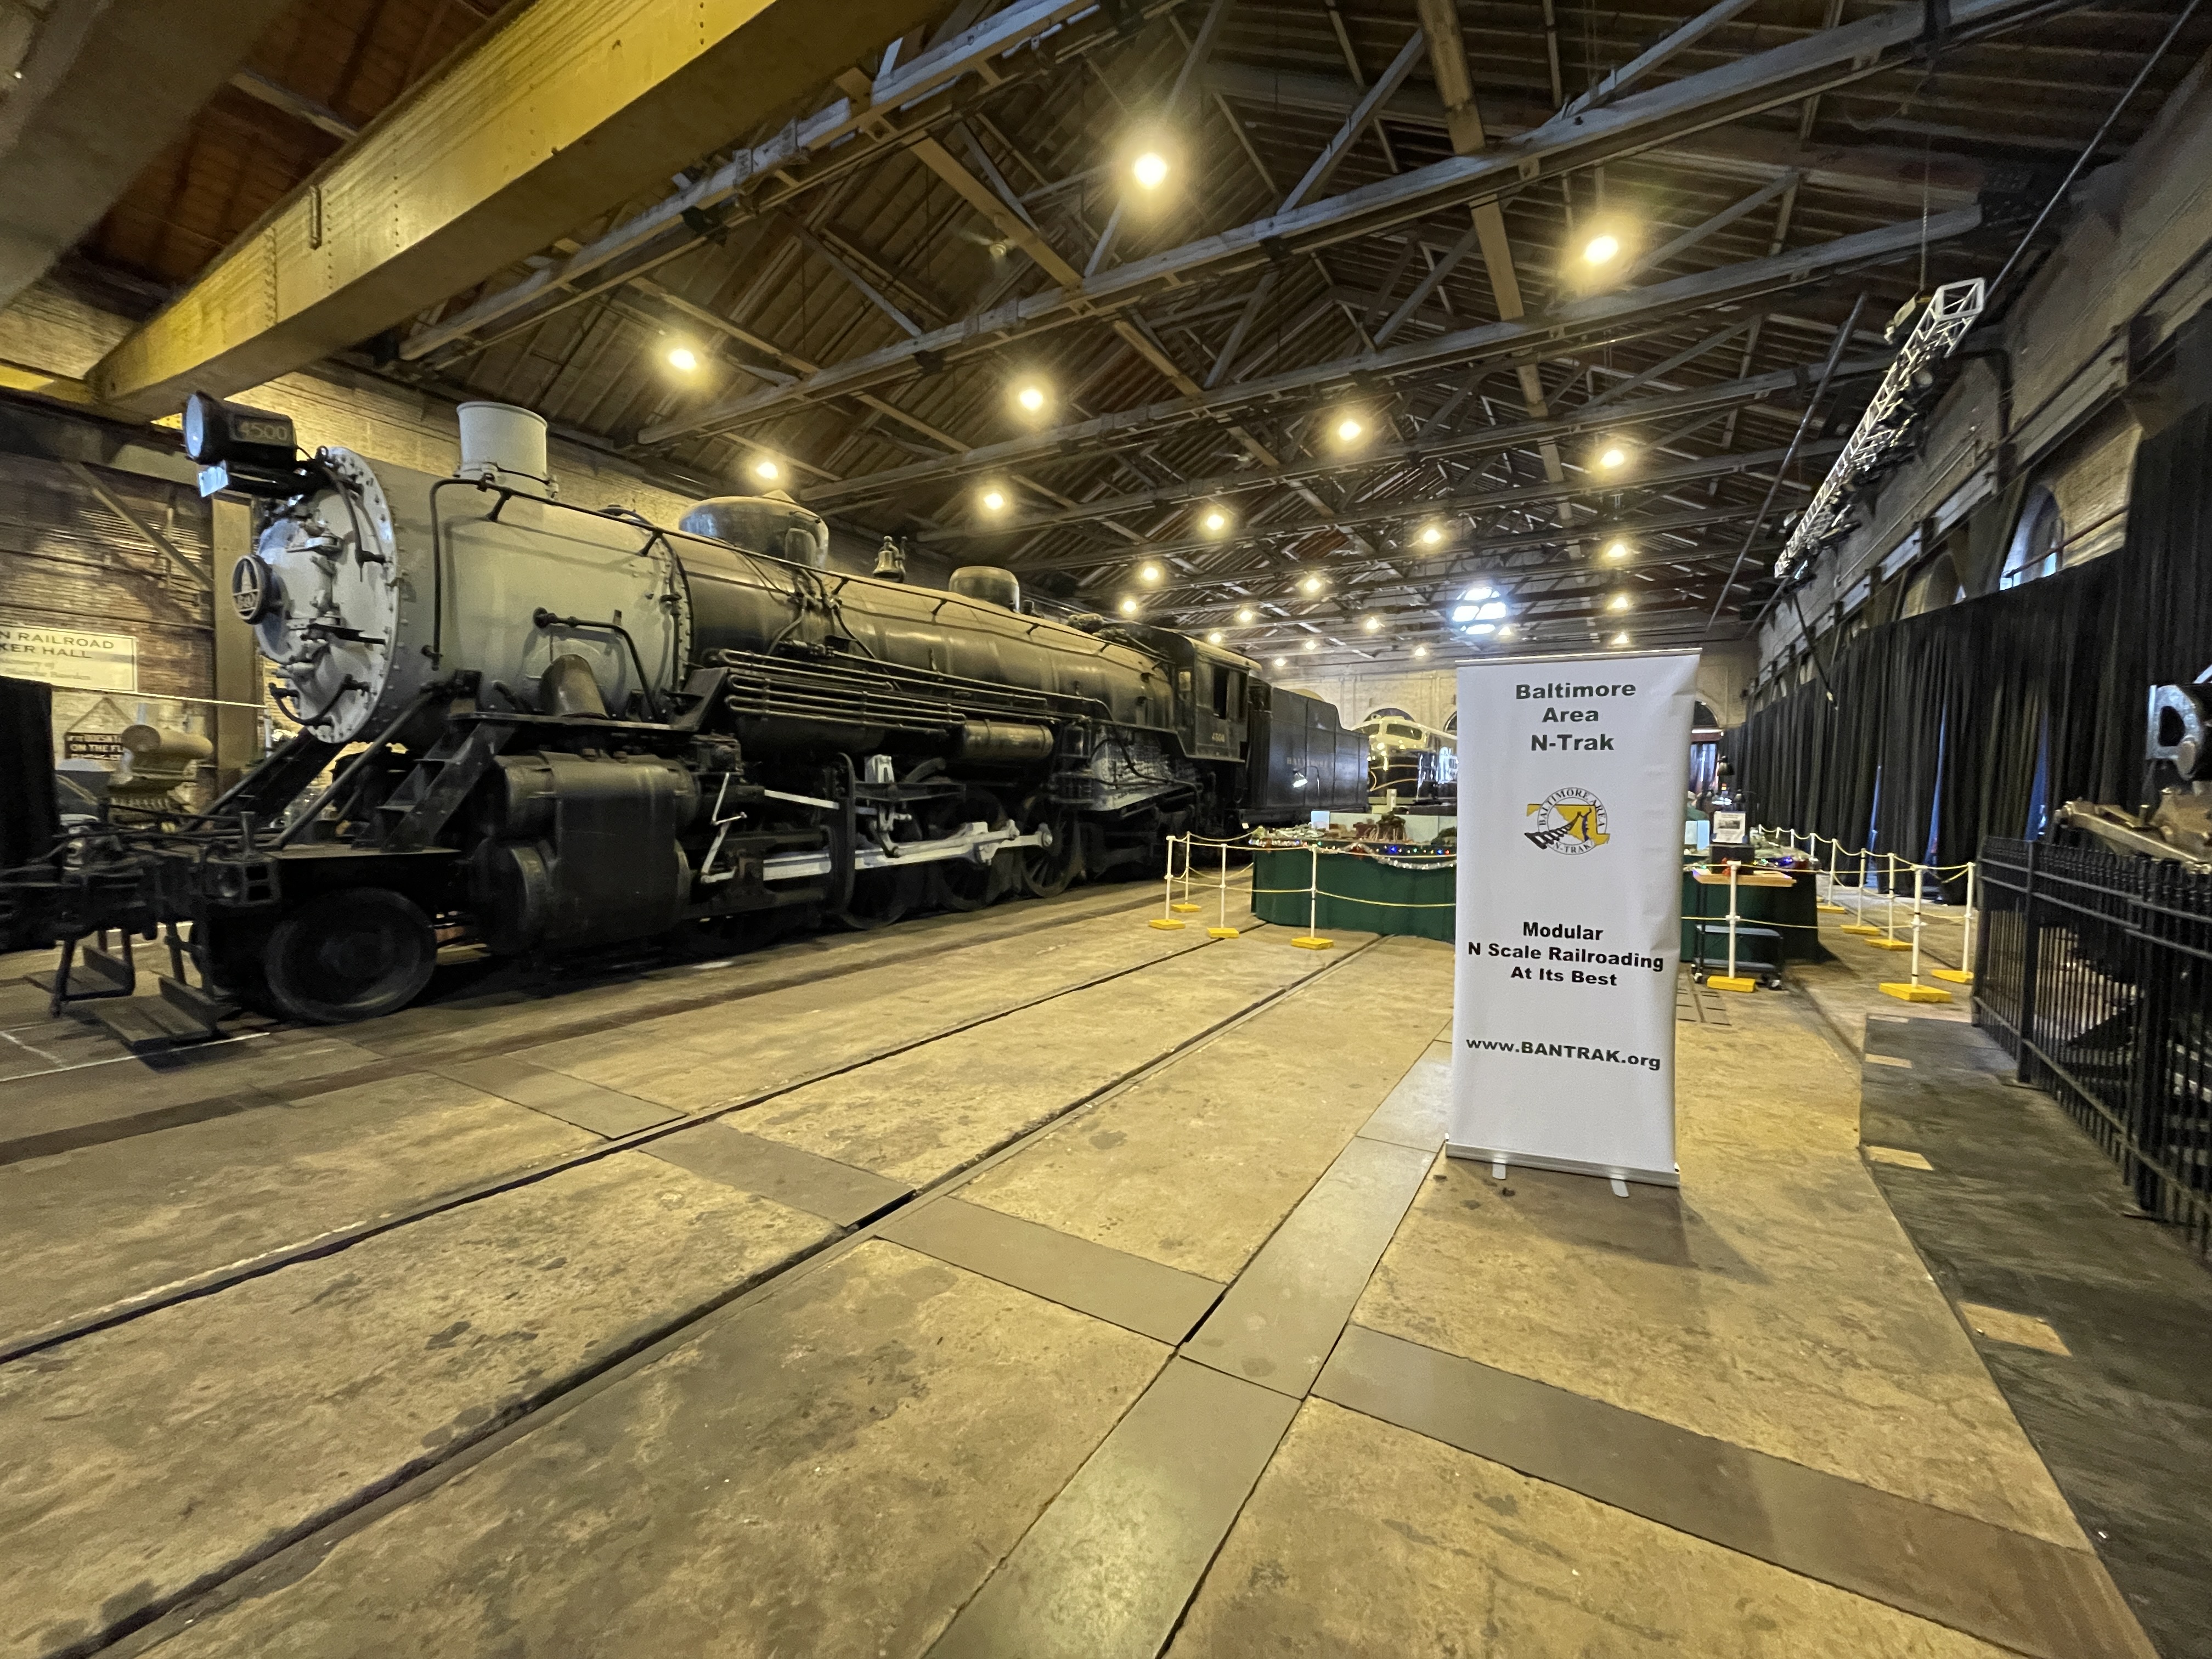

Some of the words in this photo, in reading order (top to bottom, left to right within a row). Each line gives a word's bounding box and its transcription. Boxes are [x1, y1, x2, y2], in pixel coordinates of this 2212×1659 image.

[239, 421, 287, 441] 4500
[18, 633, 114, 649] RAILROAD
[42, 646, 92, 658] HALL
[1516, 682, 1636, 699] Baltimore
[1542, 707, 1599, 723] Area
[1531, 733, 1615, 751] N-Trak
[1539, 788, 1588, 826] BALTIMORE
[1590, 799, 1606, 827] AREA
[1554, 842, 1592, 853] N-TRAK
[1523, 921, 1604, 940] Modular
[1468, 941, 1481, 955] N
[1488, 943, 1542, 959] Scale
[1549, 946, 1663, 972] Railroading
[1510, 966, 1532, 979] At
[1539, 968, 1564, 981] Its
[1571, 970, 1617, 986] Best
[1466, 1039, 1661, 1071] www.BANTRAK.org
